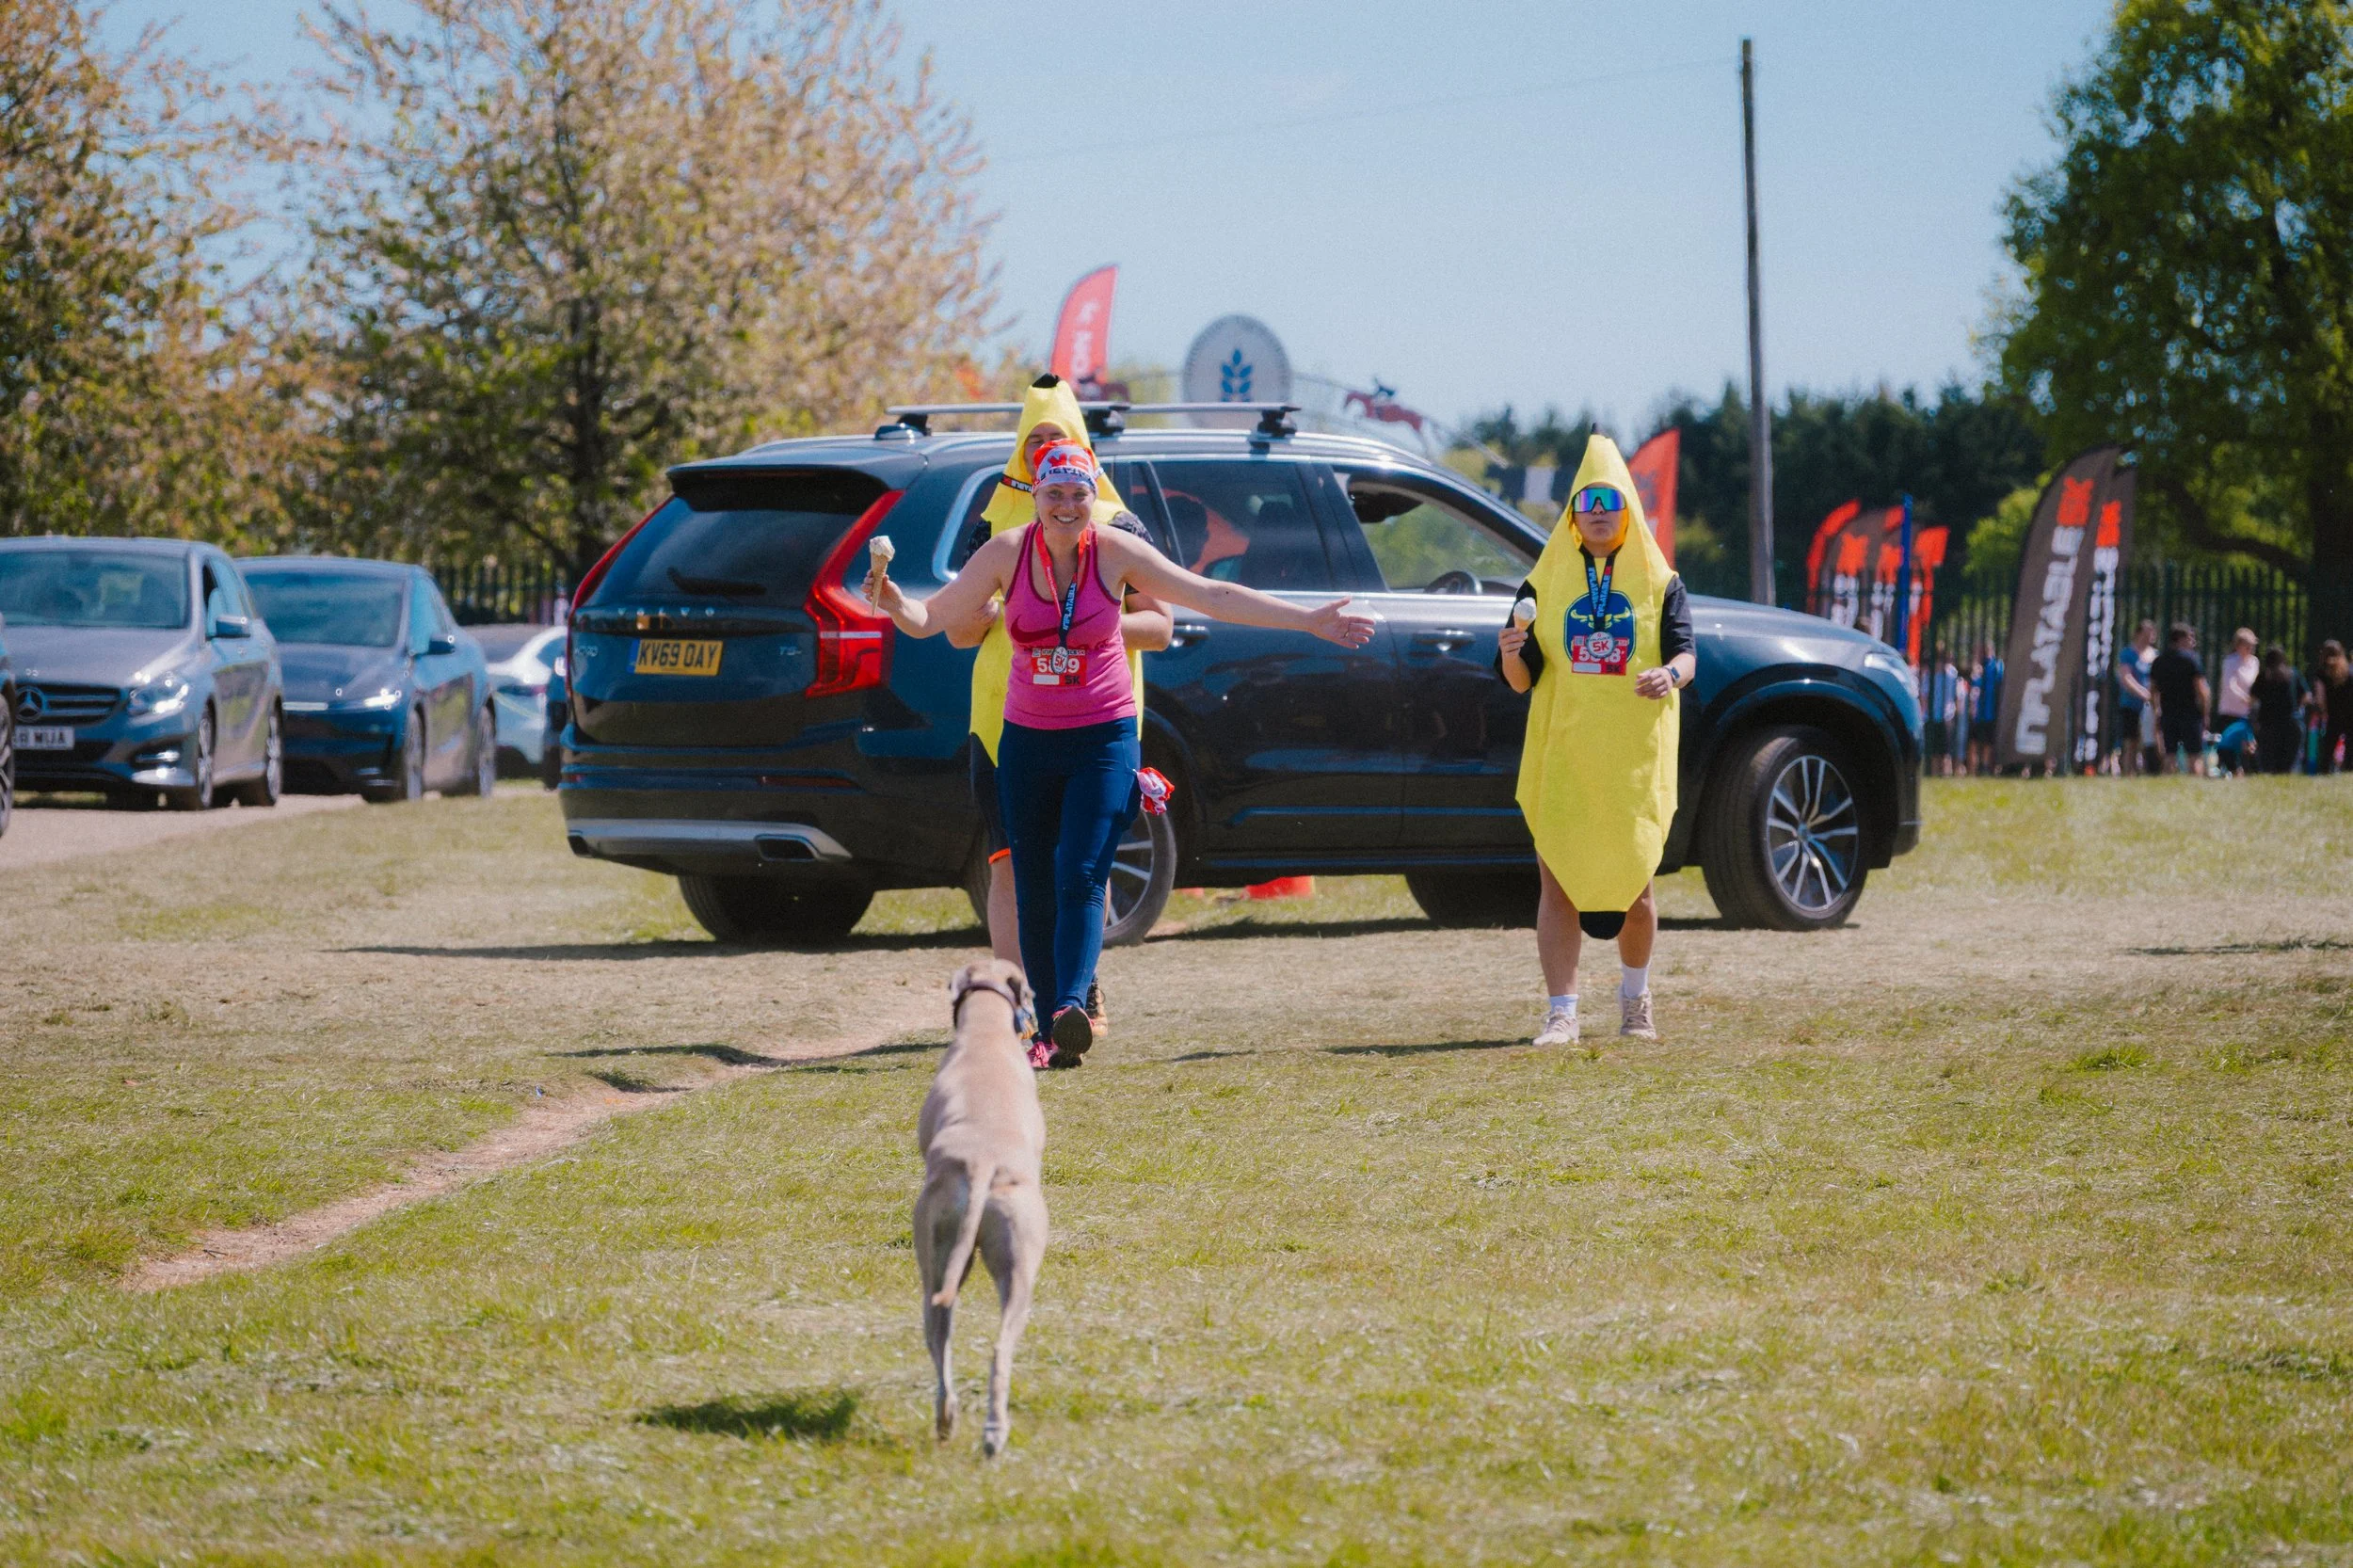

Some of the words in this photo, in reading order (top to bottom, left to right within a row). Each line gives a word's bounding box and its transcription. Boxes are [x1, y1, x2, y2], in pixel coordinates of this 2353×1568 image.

[1592, 640, 1610, 652] 5K
[1036, 657, 1080, 674] 59
[1064, 675, 1080, 685] 5K
